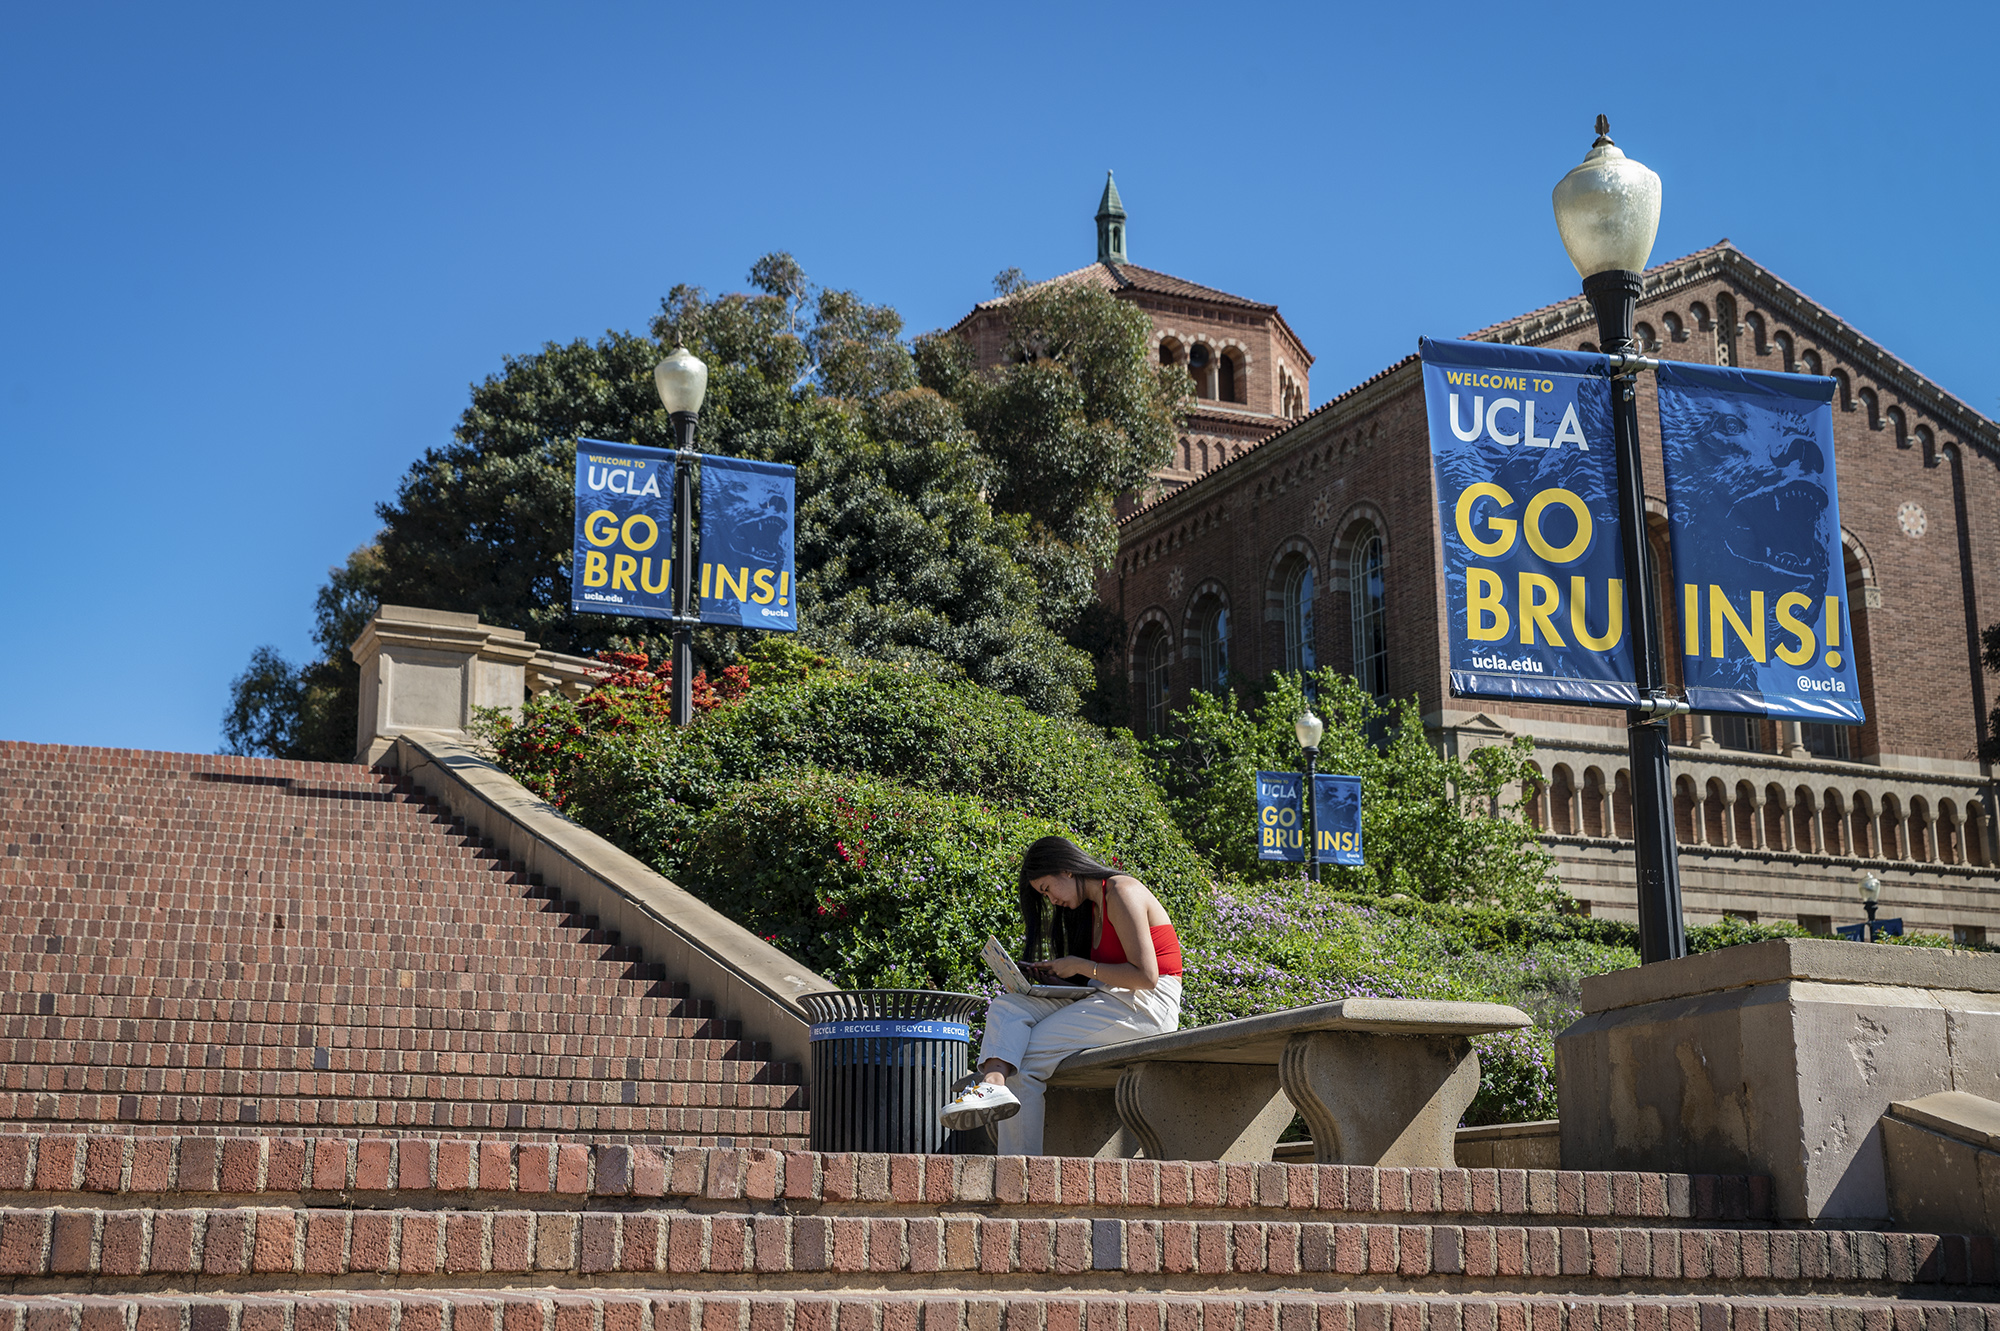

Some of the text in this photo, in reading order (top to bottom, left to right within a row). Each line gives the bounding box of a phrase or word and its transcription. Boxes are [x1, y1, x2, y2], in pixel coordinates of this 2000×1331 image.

[1447, 371, 1554, 393] WELCOME TO
[1449, 393, 1589, 451] UCLA
[589, 455, 646, 469] WELCOME TO
[588, 465, 661, 498] UCLA
[584, 510, 659, 552] GO
[1455, 482, 1593, 563] GO
[583, 550, 671, 594] BRU
[700, 562, 789, 606] INS!
[584, 592, 624, 603] ucla.edu
[761, 608, 789, 618] @ucla
[1466, 567, 1623, 652] BRU
[1684, 583, 1842, 668] INS!
[1472, 654, 1544, 673] ucla.edu
[1796, 675, 1846, 692] @ucla
[1262, 784, 1297, 799] UCLA
[1262, 806, 1296, 827] GO
[1263, 827, 1303, 849] BRU
[1317, 830, 1360, 852] INS!
[813, 1026, 837, 1036] RECYCLE
[844, 1025, 881, 1033] RECYCLE
[895, 1025, 933, 1033] RECYCLE
[942, 1026, 965, 1037] RECYCLE
